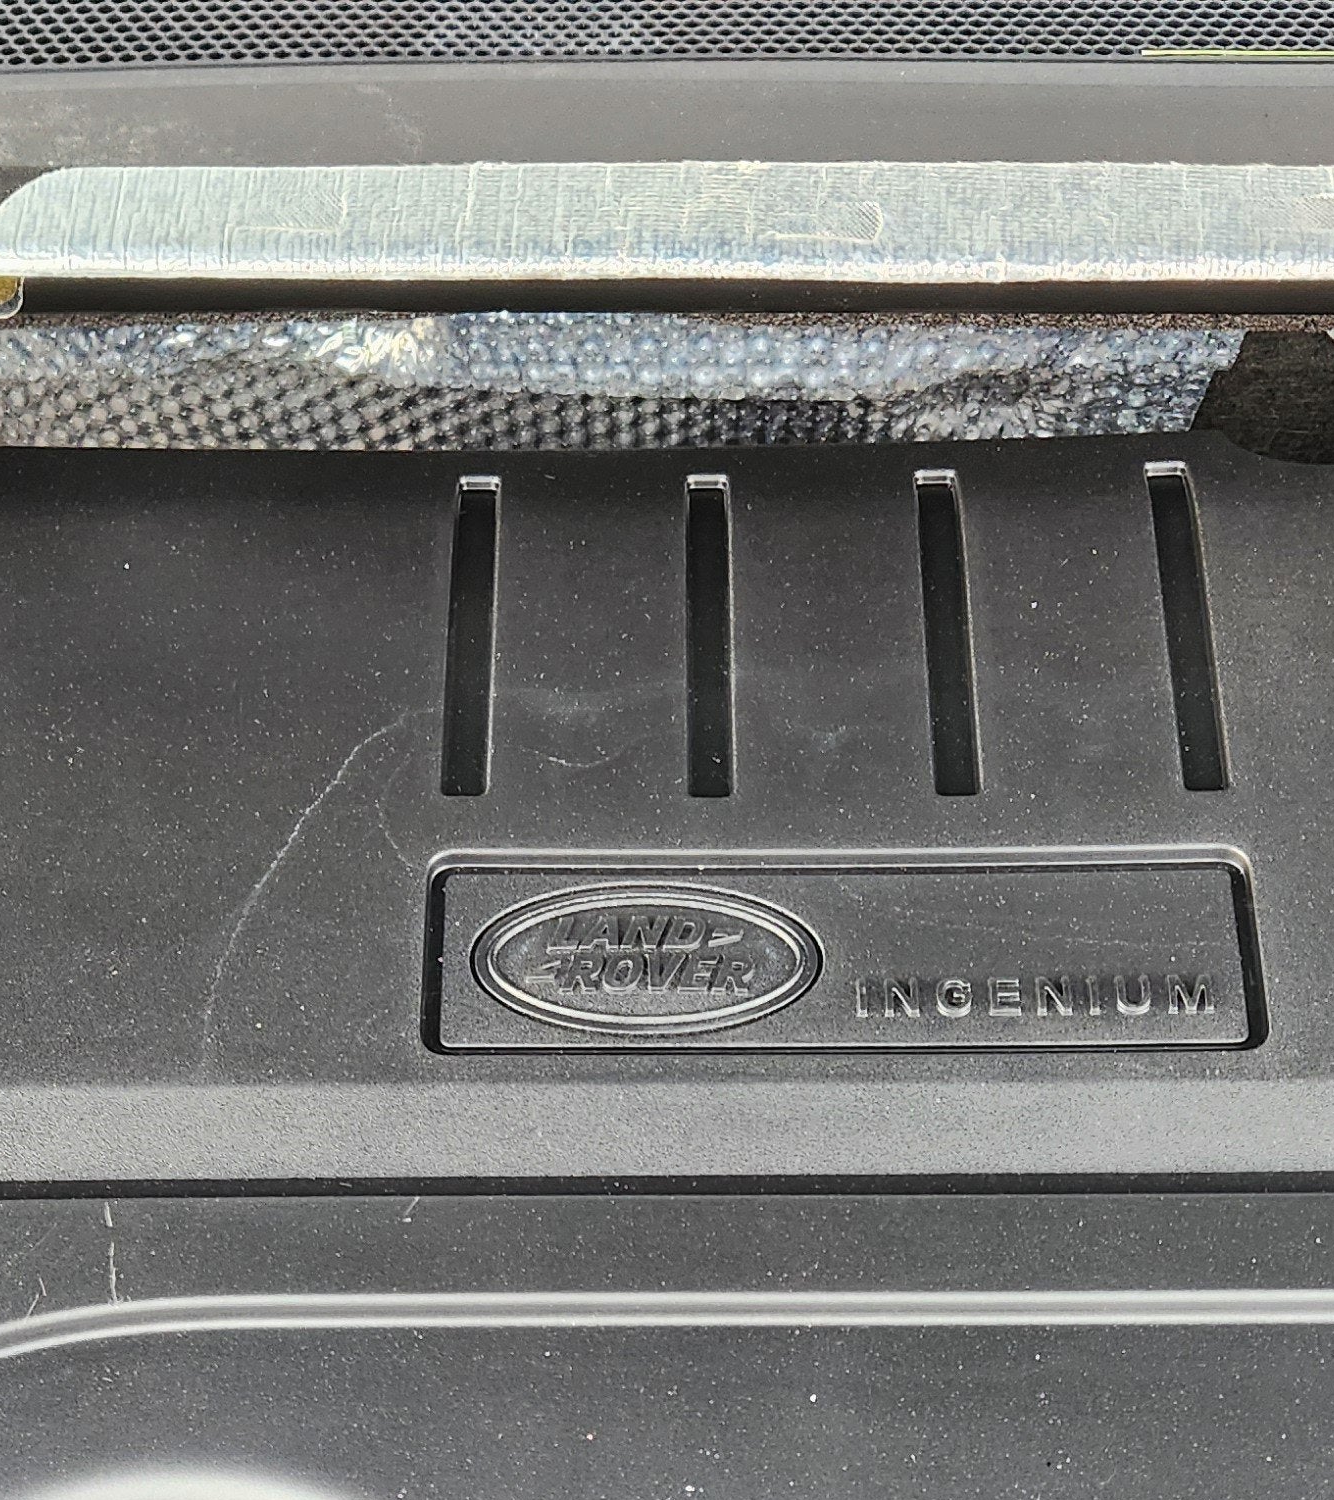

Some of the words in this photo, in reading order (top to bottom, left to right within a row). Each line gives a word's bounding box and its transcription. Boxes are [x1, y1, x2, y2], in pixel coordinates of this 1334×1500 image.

[546, 914, 707, 952] LAND
[559, 953, 755, 995] ROVER
[856, 975, 1215, 1017] INGENIUM
